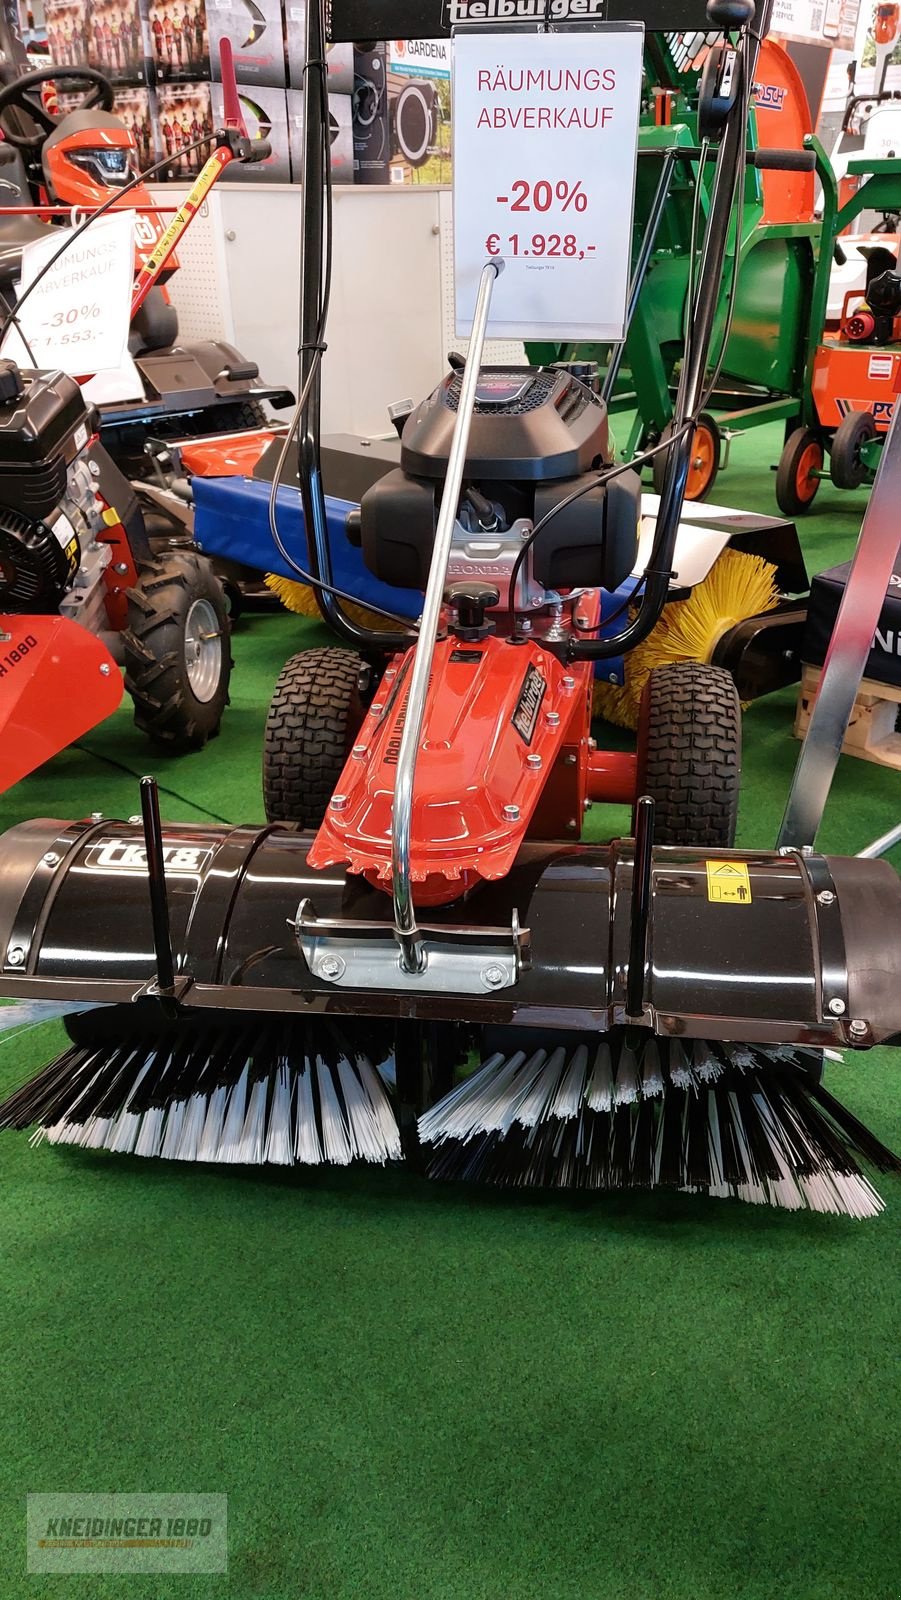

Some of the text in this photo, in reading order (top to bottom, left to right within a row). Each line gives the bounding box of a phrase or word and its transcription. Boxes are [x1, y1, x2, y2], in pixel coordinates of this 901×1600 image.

[407, 40, 447, 60] GARDENA
[478, 65, 616, 91] RÄUMUNGS
[477, 107, 614, 129] ABVERKAUF
[496, 180, 588, 212] -20%
[485, 233, 596, 260] € 1.928,-
[36, 259, 116, 296] ABVERKAUF
[41, 302, 101, 327] -30%
[448, 565, 512, 576] HONDA
[4, 635, 38, 667] 1880
